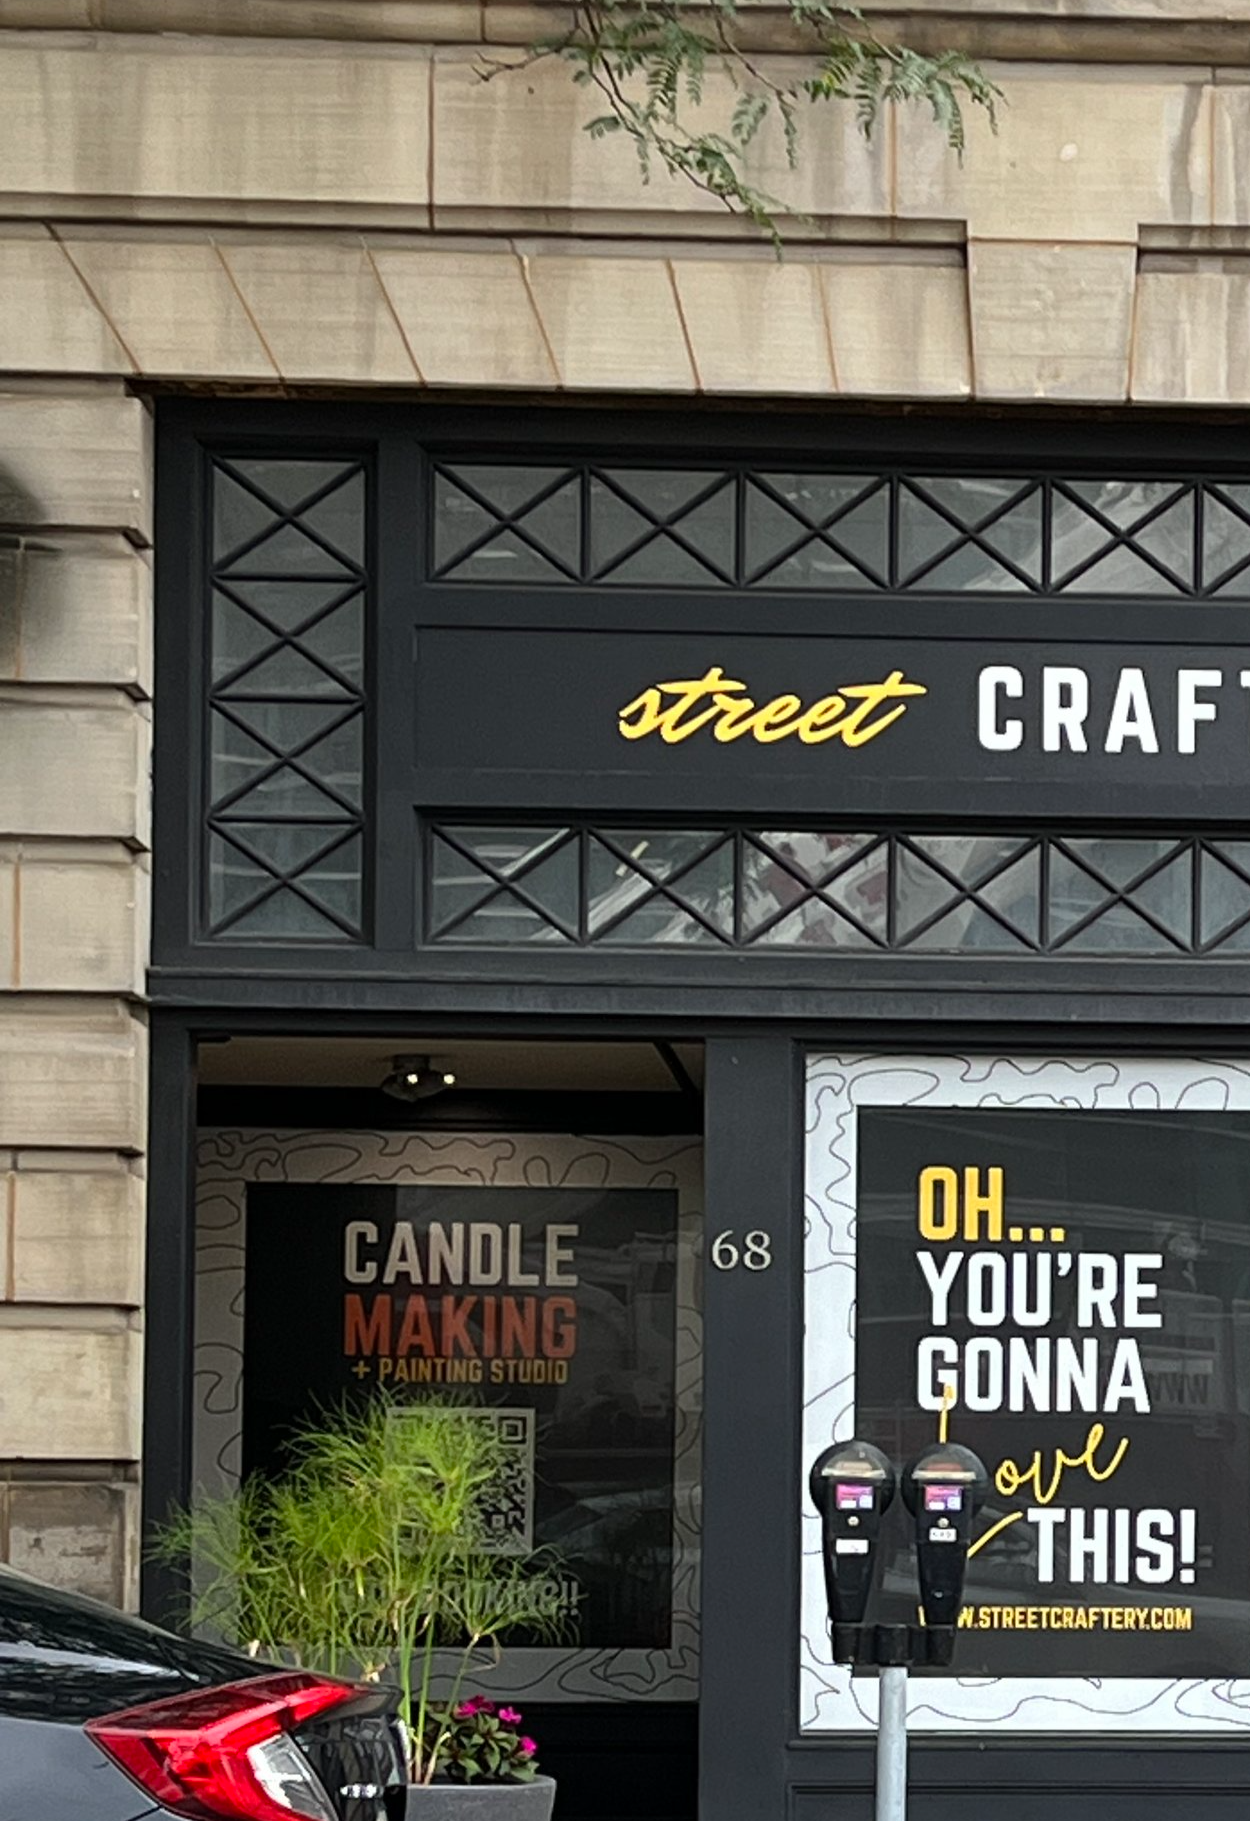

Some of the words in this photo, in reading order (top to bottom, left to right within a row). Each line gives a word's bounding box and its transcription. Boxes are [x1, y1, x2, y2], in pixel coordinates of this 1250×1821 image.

[618, 666, 927, 748] street
[918, 1166, 1066, 1243] OH...
[344, 1221, 579, 1287] CANDLE
[712, 1229, 771, 1270] 68
[915, 1251, 1163, 1328] YOU'RE
[344, 1293, 577, 1358] MAKING
[378, 1358, 483, 1383] PAINTING
[490, 1359, 568, 1384] STUDIO
[917, 1336, 1151, 1413] GONNA
[1027, 1507, 1197, 1584] THIS!
[918, 1604, 1193, 1631] W.STREETCRAFTERY.COM
